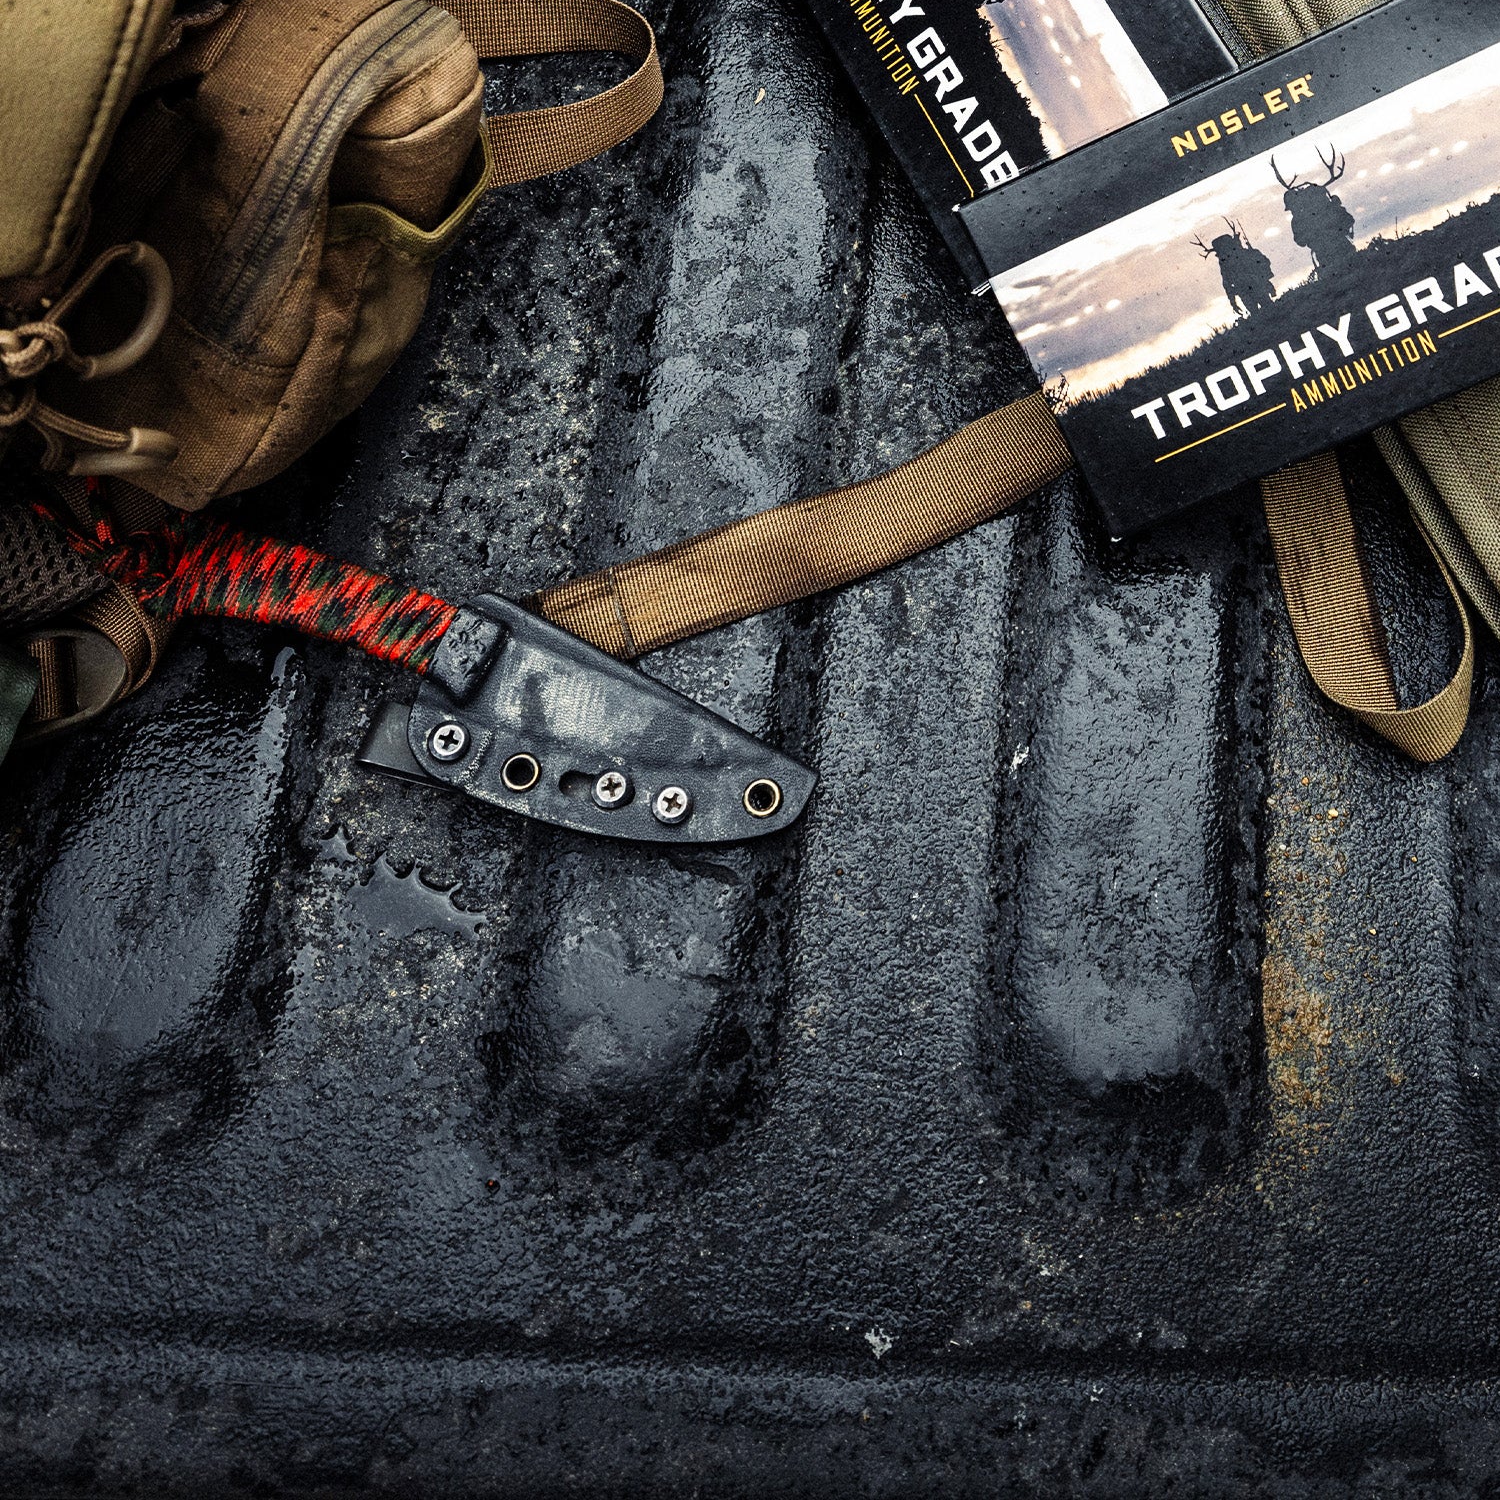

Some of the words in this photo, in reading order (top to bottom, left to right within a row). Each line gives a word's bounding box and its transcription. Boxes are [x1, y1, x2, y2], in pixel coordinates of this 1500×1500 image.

[906, 26, 1020, 190] GRADE
[1170, 75, 1315, 157] NOSLER
[1130, 312, 1355, 440] TROPHY
[1290, 331, 1438, 413] AMMUNITION
